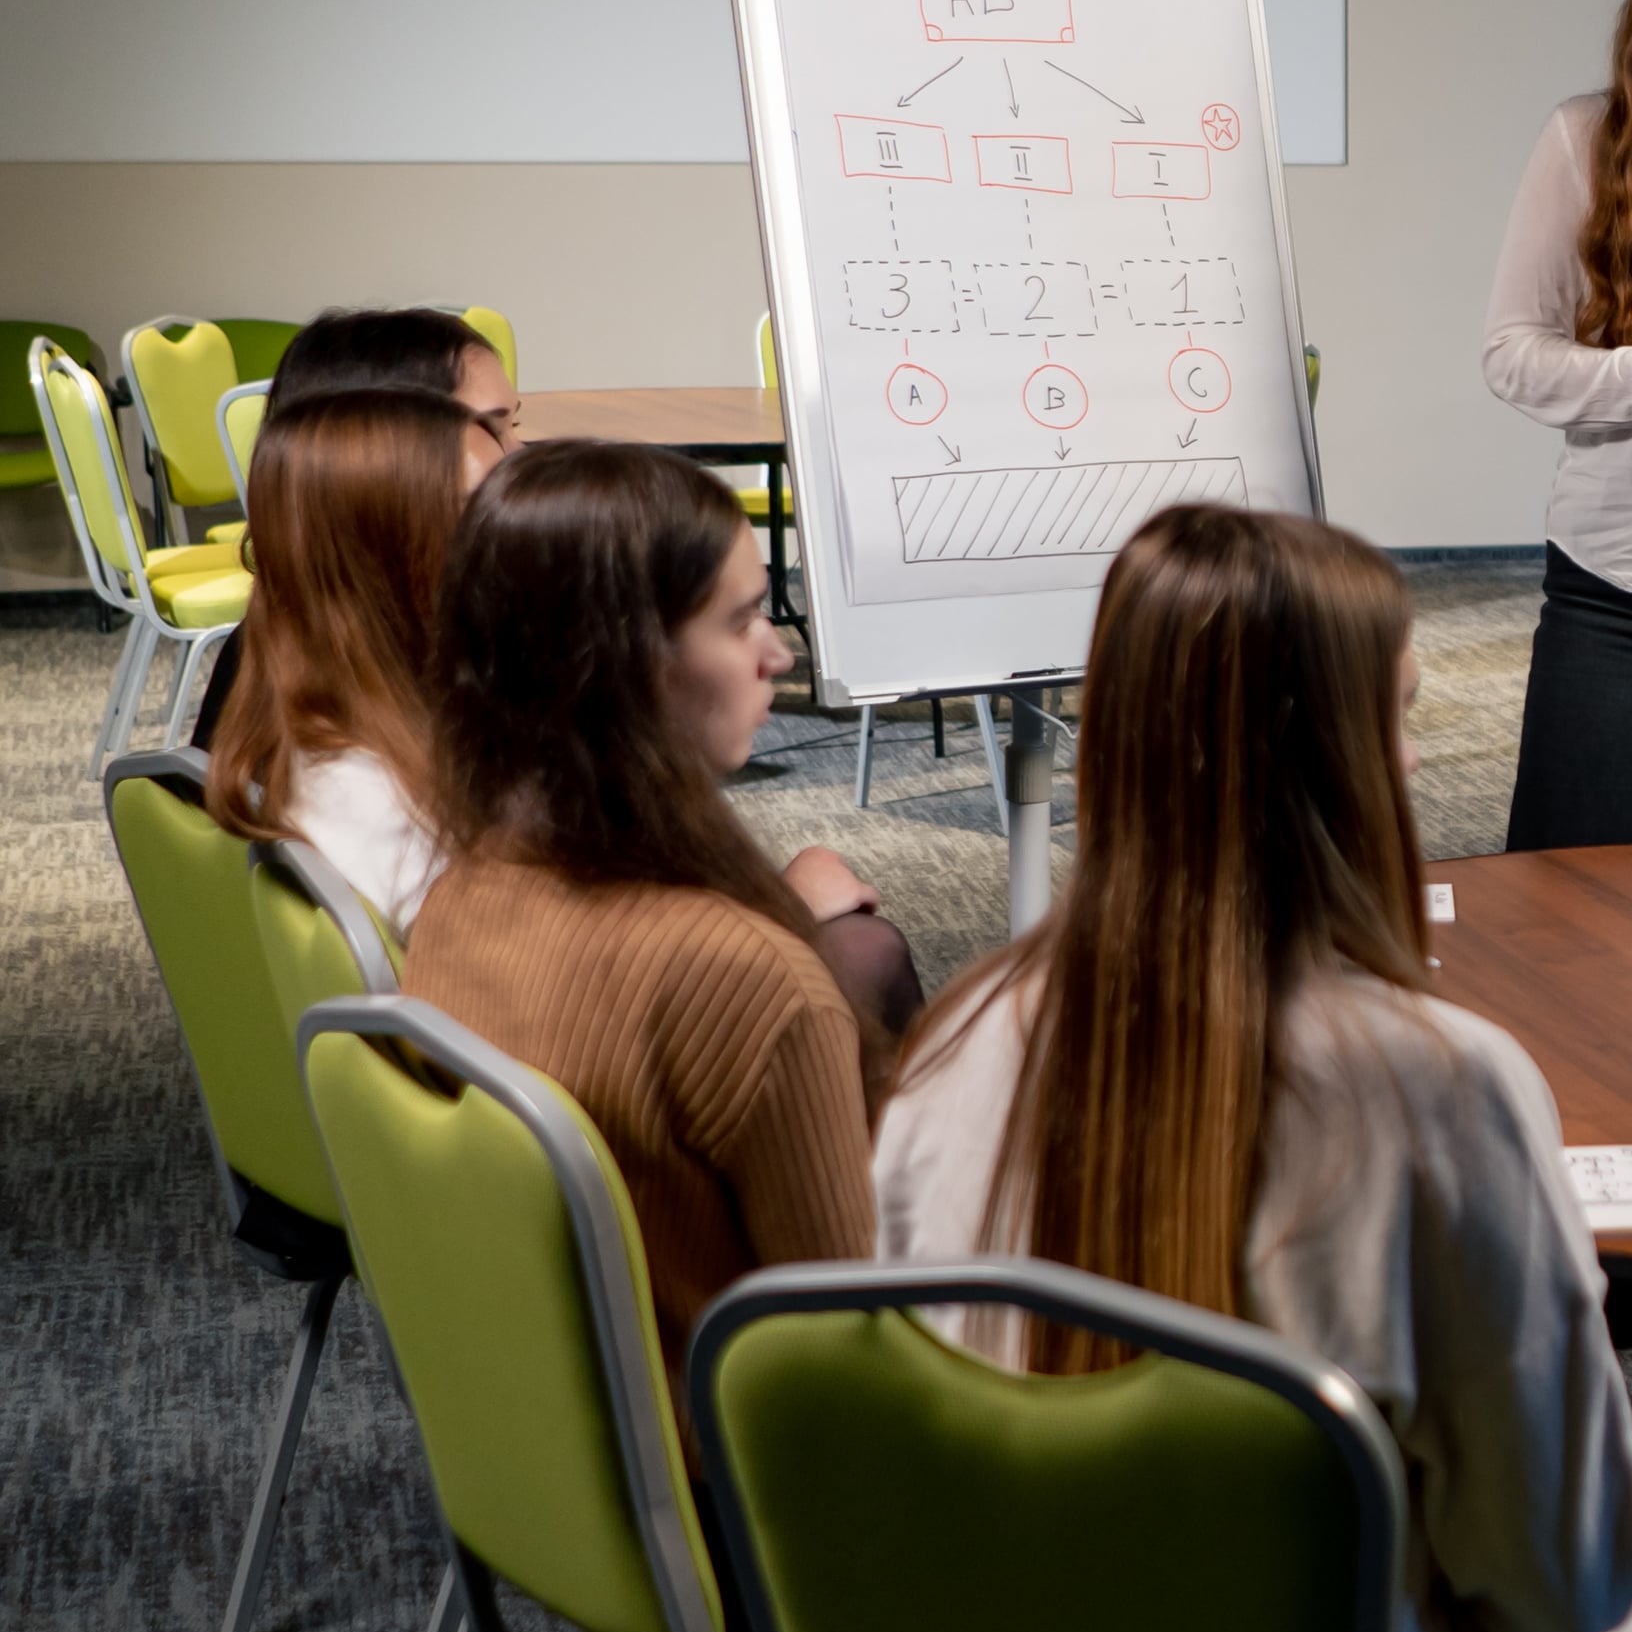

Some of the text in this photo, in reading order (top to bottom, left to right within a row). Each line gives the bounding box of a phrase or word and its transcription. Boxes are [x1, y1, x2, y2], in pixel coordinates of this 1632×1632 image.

[875, 131, 904, 169] III
[1009, 145, 1033, 182] II
[1148, 151, 1169, 187] I
[881, 273, 911, 319] 3
[1024, 275, 1054, 321] 2
[1170, 272, 1199, 314] 1
[908, 383, 923, 407] A
[1043, 385, 1066, 411] B
[1187, 366, 1208, 399] C
